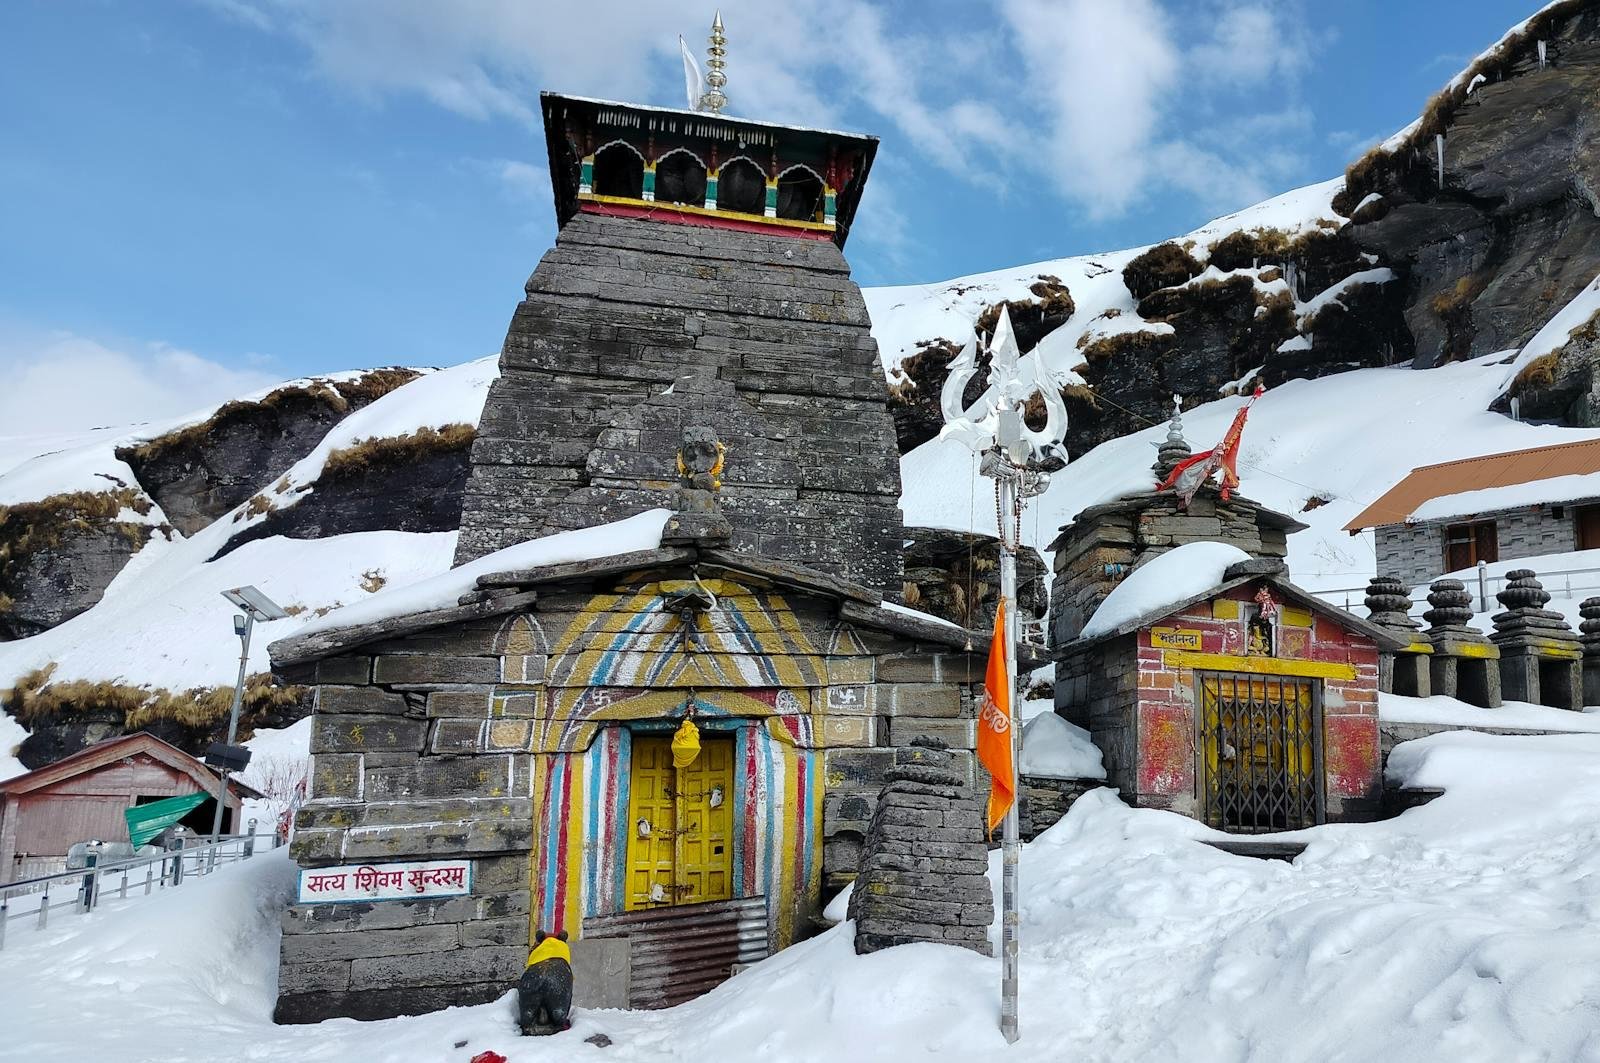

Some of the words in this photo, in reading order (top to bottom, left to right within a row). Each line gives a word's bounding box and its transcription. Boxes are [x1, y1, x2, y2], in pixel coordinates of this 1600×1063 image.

[307, 874, 347, 892] सत्य
[353, 866, 404, 892] शिवम्
[408, 867, 465, 893] सुन्दरम्
